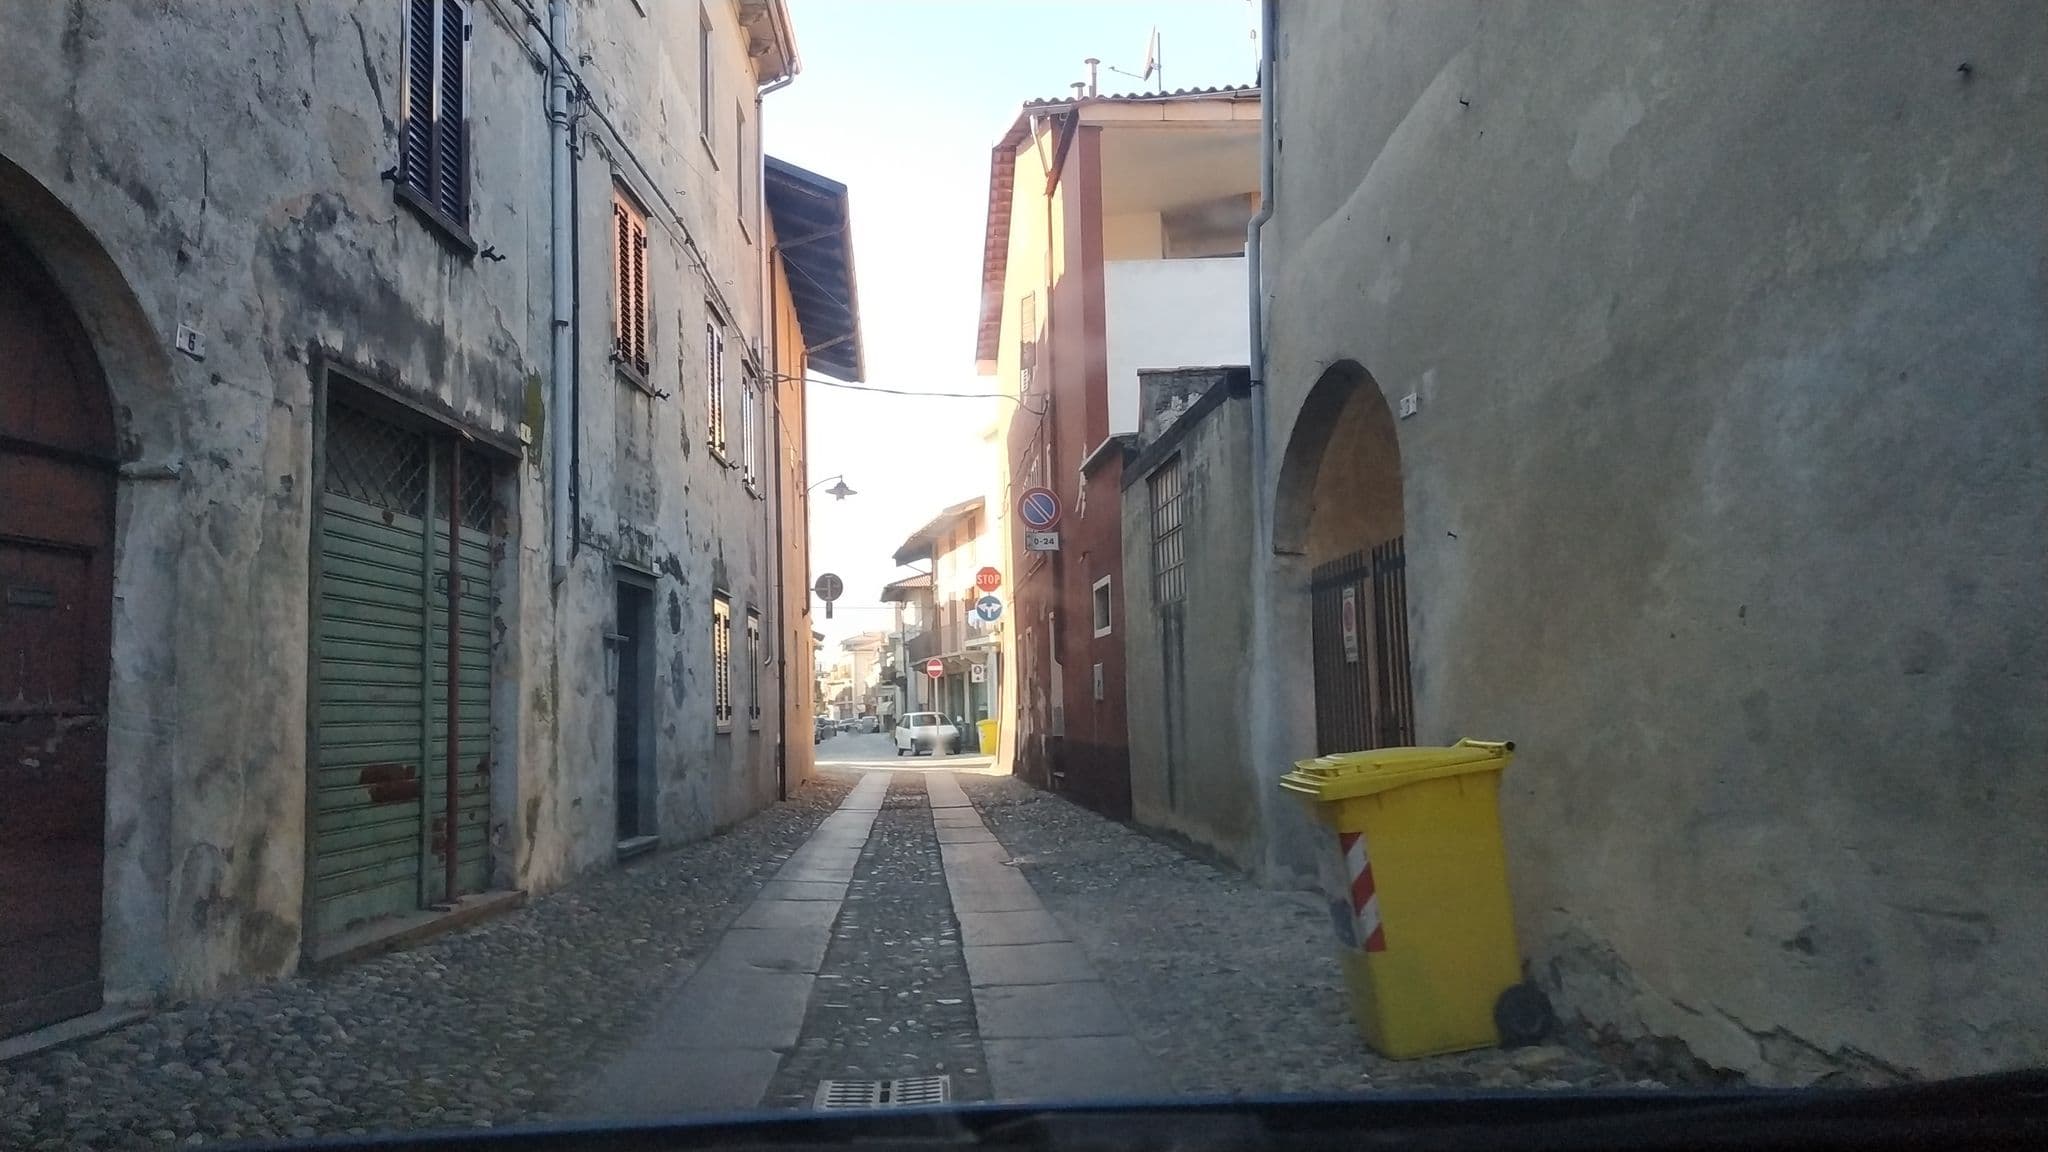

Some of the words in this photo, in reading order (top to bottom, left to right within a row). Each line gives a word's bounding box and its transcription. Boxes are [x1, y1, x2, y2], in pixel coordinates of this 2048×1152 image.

[188, 332, 196, 351] 6
[1033, 537, 1055, 545] 0-24
[976, 574, 1000, 585] STOP
